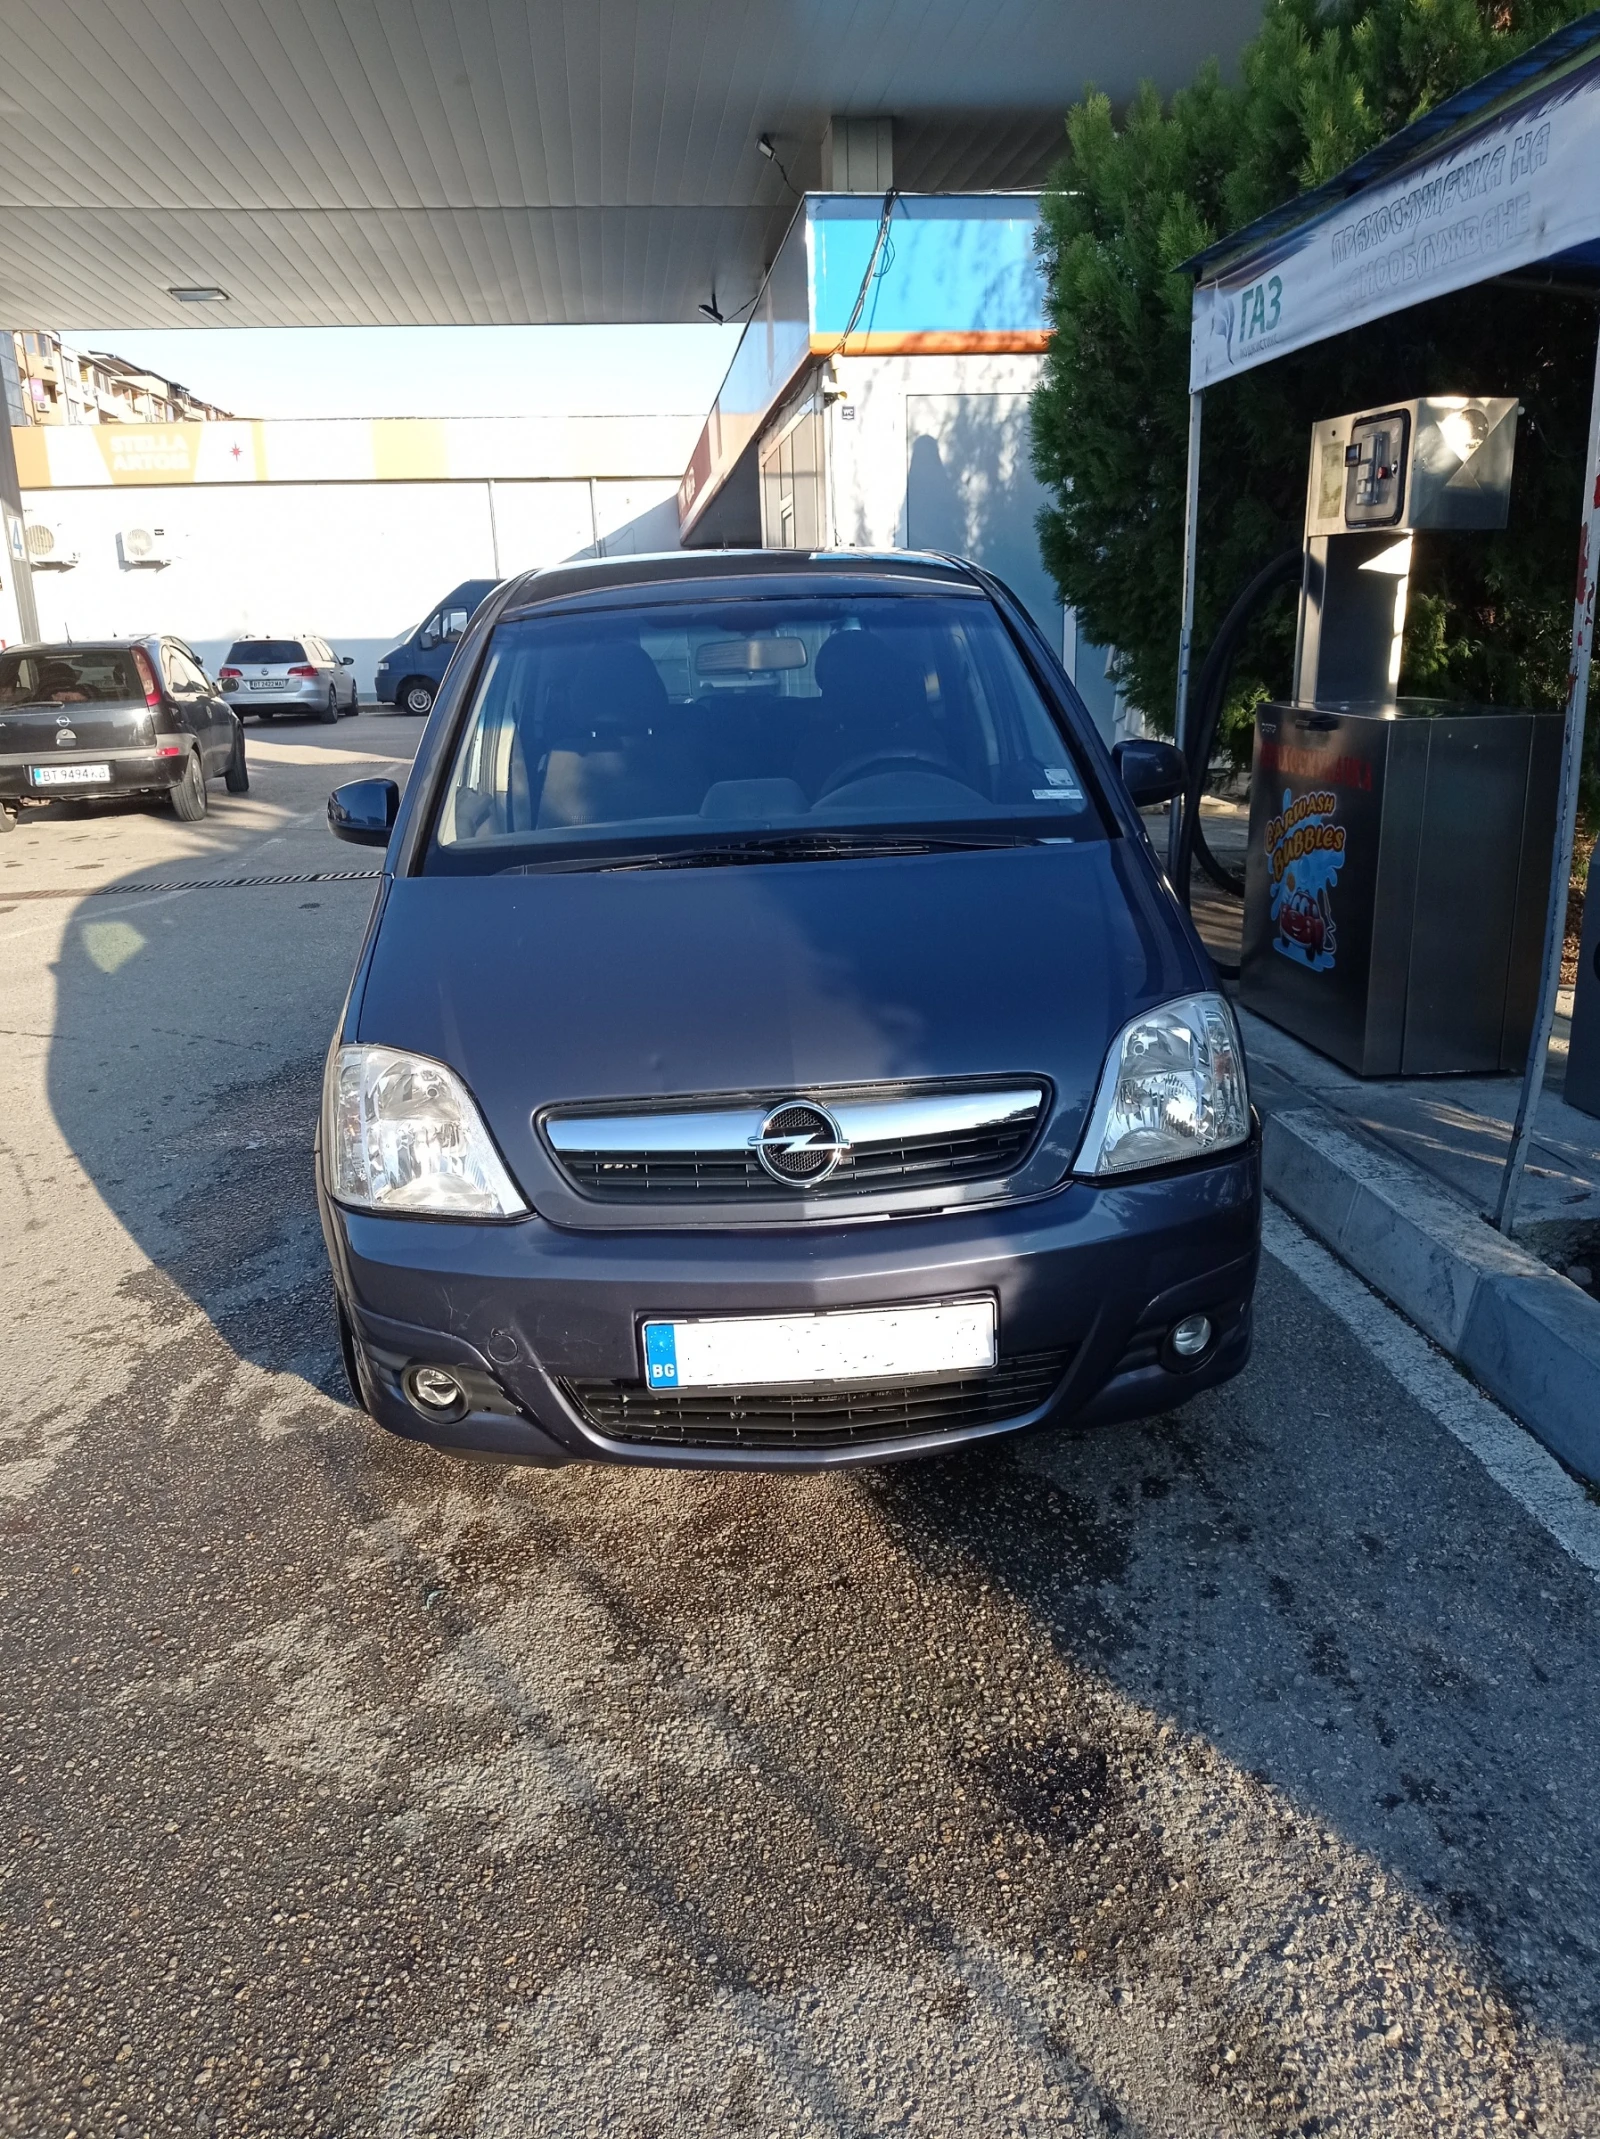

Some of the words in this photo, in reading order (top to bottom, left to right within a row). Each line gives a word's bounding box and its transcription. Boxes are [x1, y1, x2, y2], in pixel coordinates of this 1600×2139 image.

[1510, 121, 1551, 186] НА
[1239, 275, 1283, 344] ГАЗ
[110, 434, 189, 452] STELLA
[113, 451, 192, 471] ARTOIS
[13, 520, 23, 558] 4
[43, 770, 57, 781] BT
[60, 768, 88, 780] 9494
[1264, 791, 1337, 857] CARWASH
[1273, 824, 1345, 883] BUBBLES
[652, 1363, 675, 1379] BG
